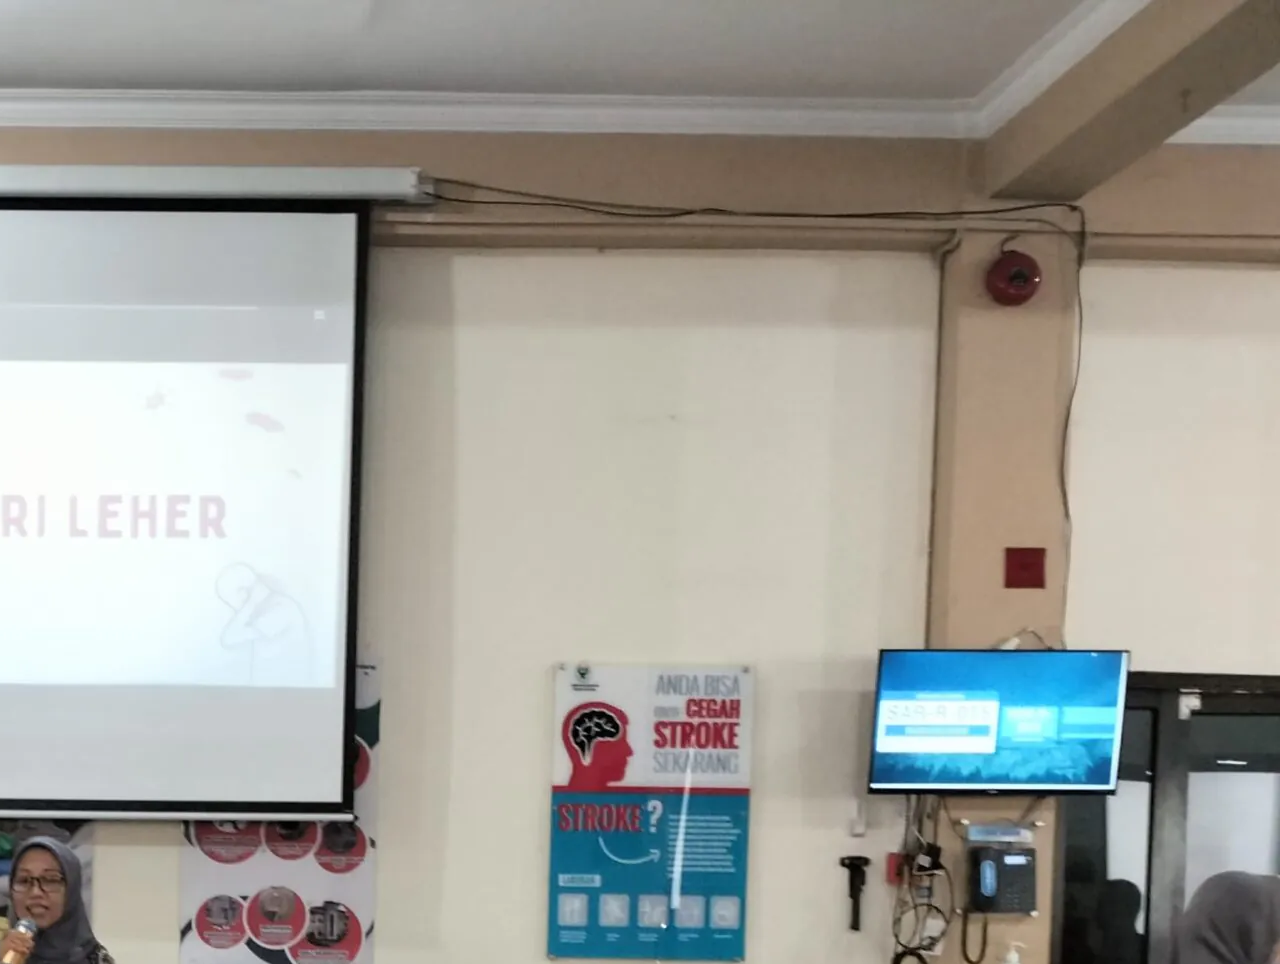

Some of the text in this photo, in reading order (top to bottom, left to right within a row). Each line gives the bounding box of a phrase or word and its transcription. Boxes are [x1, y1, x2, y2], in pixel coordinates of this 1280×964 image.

[69, 493, 227, 539] LEHER
[656, 674, 740, 696] ANDA BISA
[686, 699, 740, 719] CEGAH
[654, 721, 740, 749] STROKE
[653, 751, 739, 774] SEKARANG
[558, 799, 663, 833] STROKE ?
